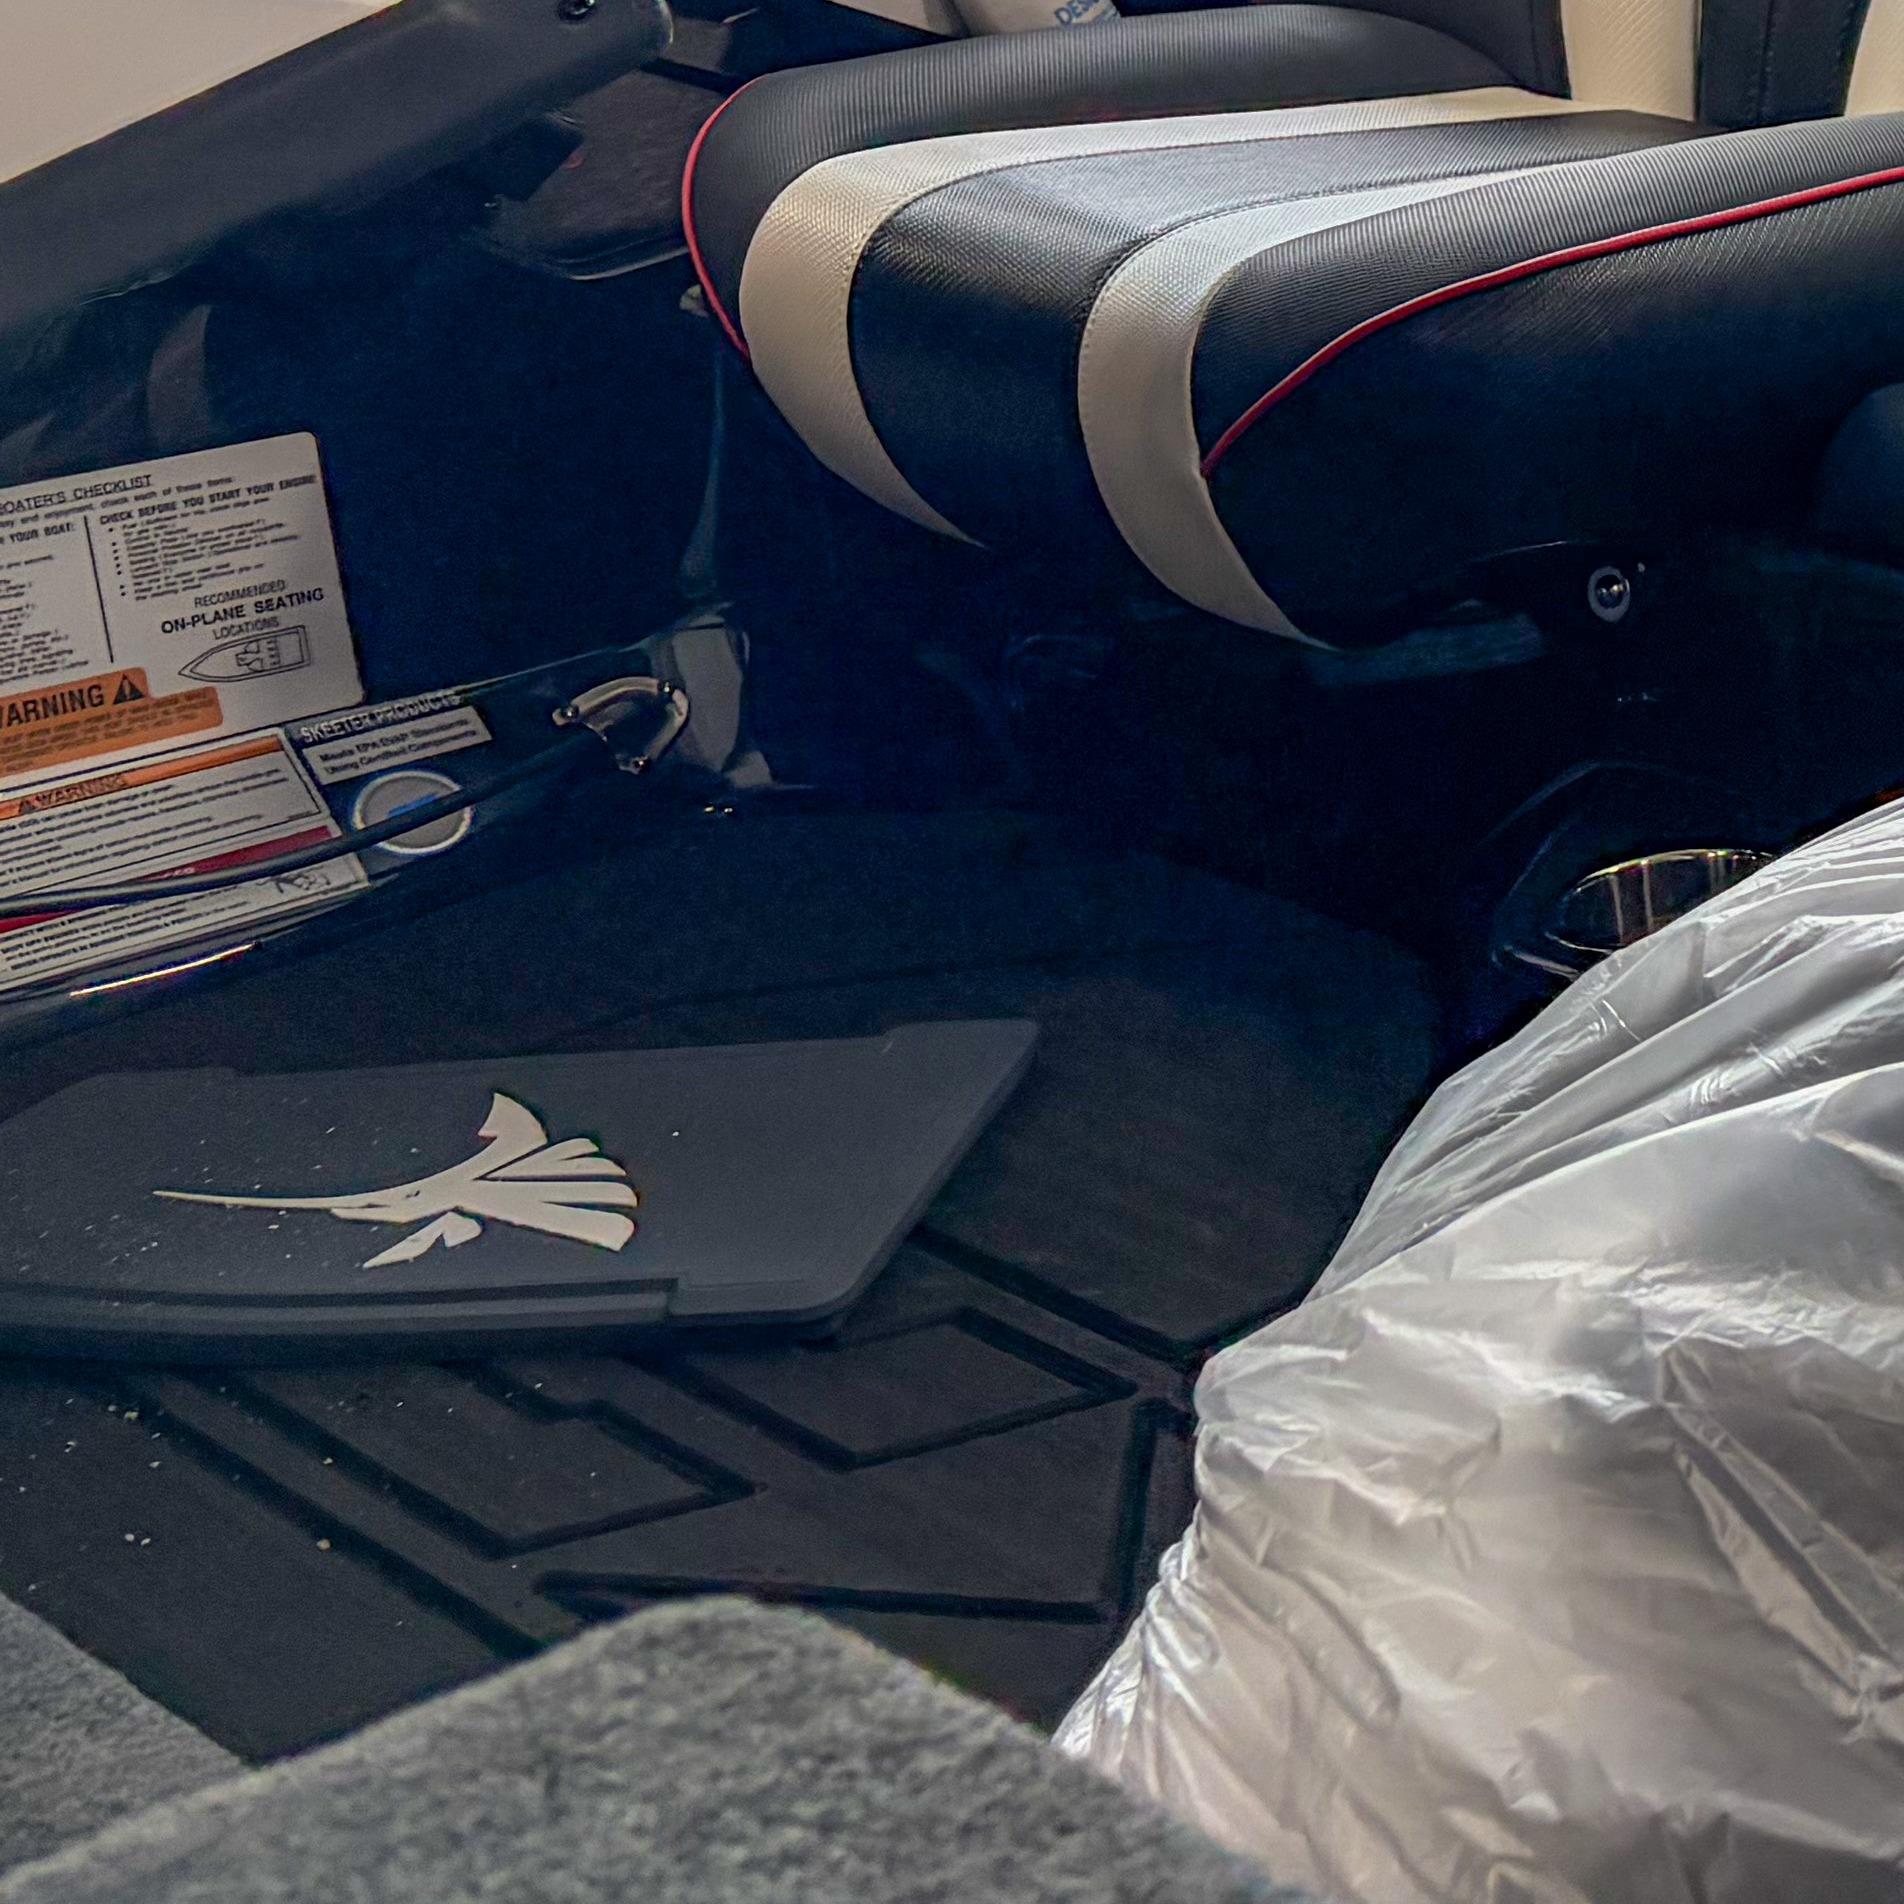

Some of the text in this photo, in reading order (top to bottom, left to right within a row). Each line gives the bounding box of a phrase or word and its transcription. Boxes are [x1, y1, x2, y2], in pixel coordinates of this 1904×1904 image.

[73, 473, 153, 501] CHECKLIST
[194, 579, 287, 608] RECOMMENDED
[161, 587, 324, 635] ON-PLANE SEATING
[212, 615, 280, 641] LOCATIONS
[0, 683, 105, 729] ARNING
